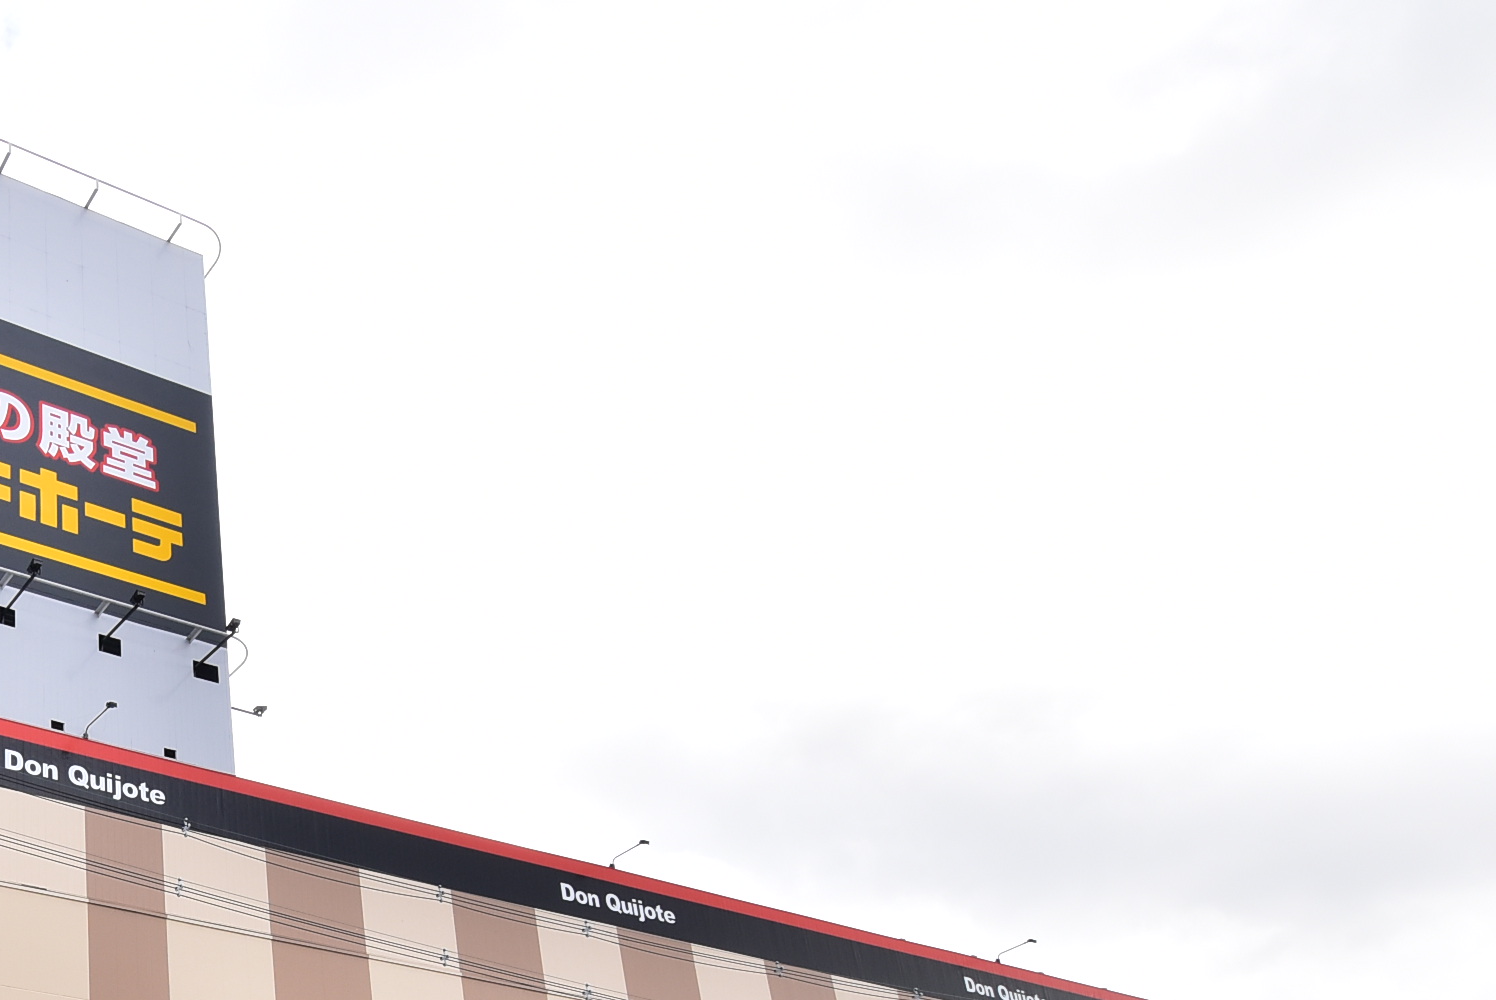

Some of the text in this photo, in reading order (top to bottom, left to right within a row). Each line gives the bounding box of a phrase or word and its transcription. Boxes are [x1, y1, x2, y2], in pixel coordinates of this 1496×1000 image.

[4, 748, 167, 806] Don Quijote
[559, 882, 677, 924] Don Quijote
[963, 976, 996, 998] Don
